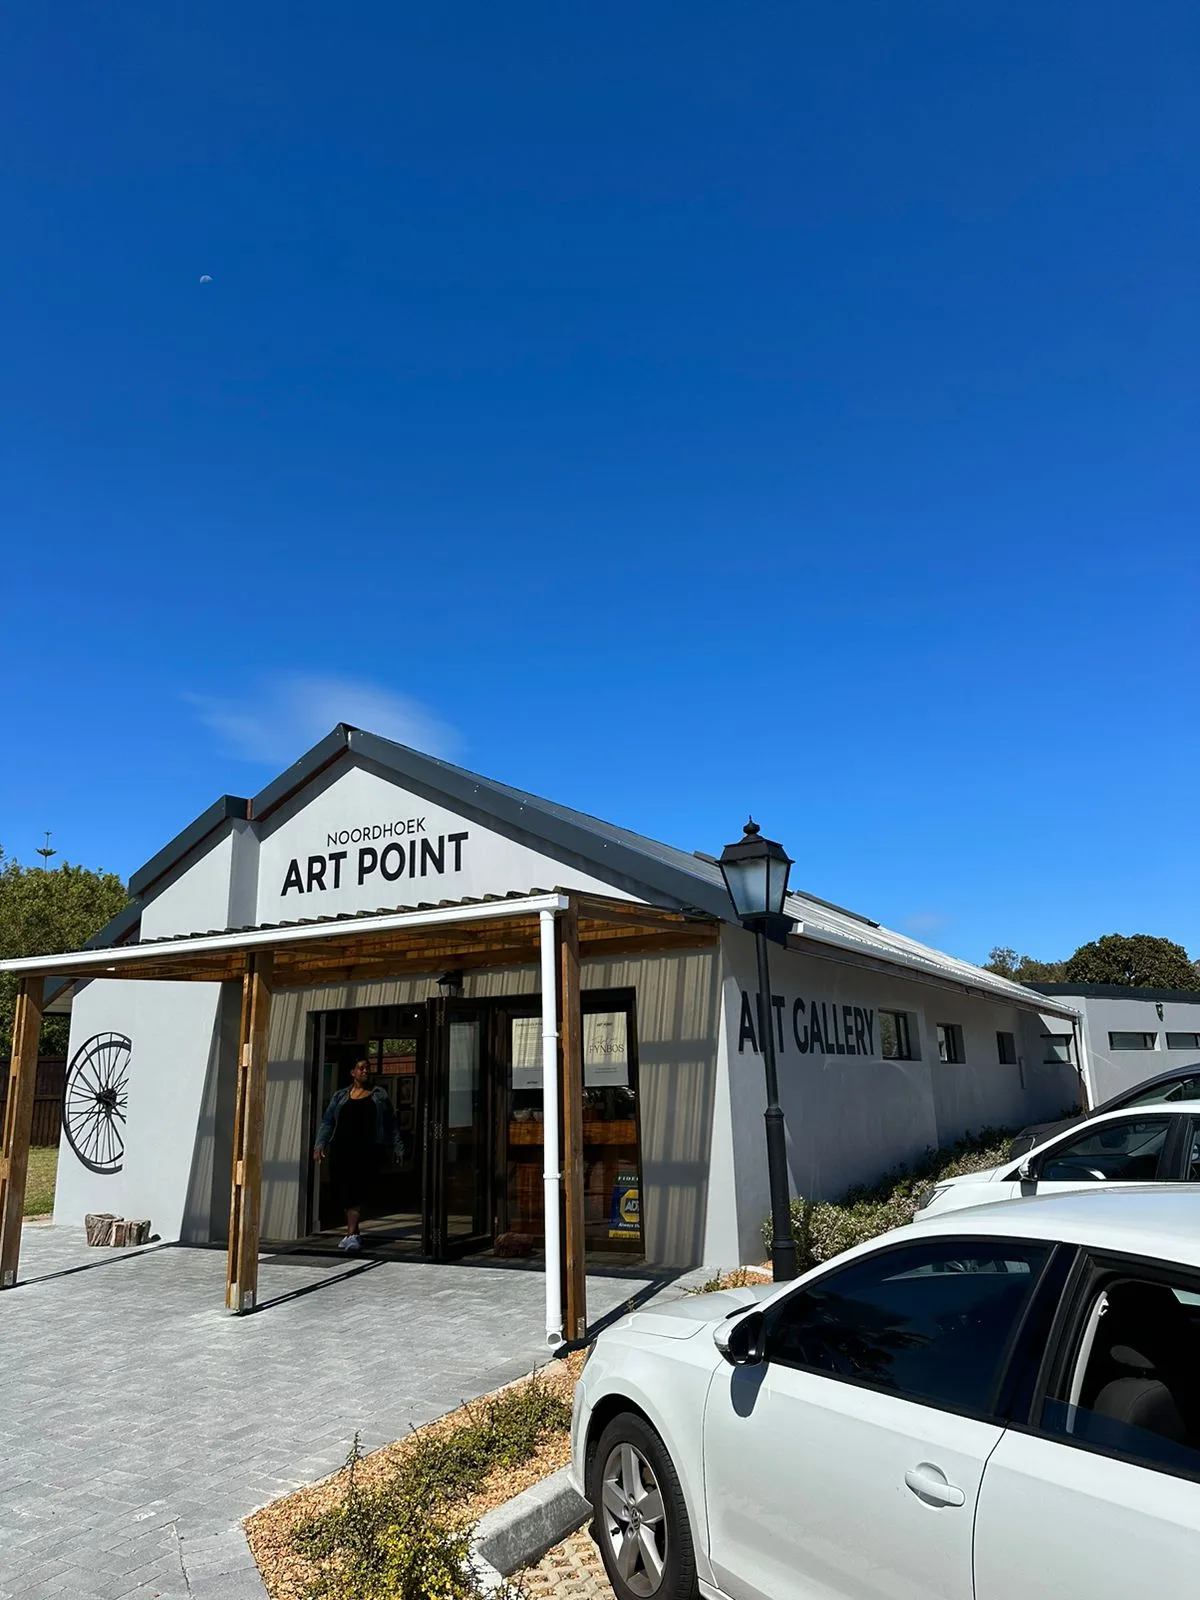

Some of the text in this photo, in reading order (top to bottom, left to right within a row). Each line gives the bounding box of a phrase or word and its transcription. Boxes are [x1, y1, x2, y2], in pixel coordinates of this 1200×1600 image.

[327, 817, 426, 847] NOORDHOEK
[280, 832, 469, 896] ART POINT
[792, 997, 874, 1055] GALLERY
[589, 1044, 624, 1054] FYNBOS
